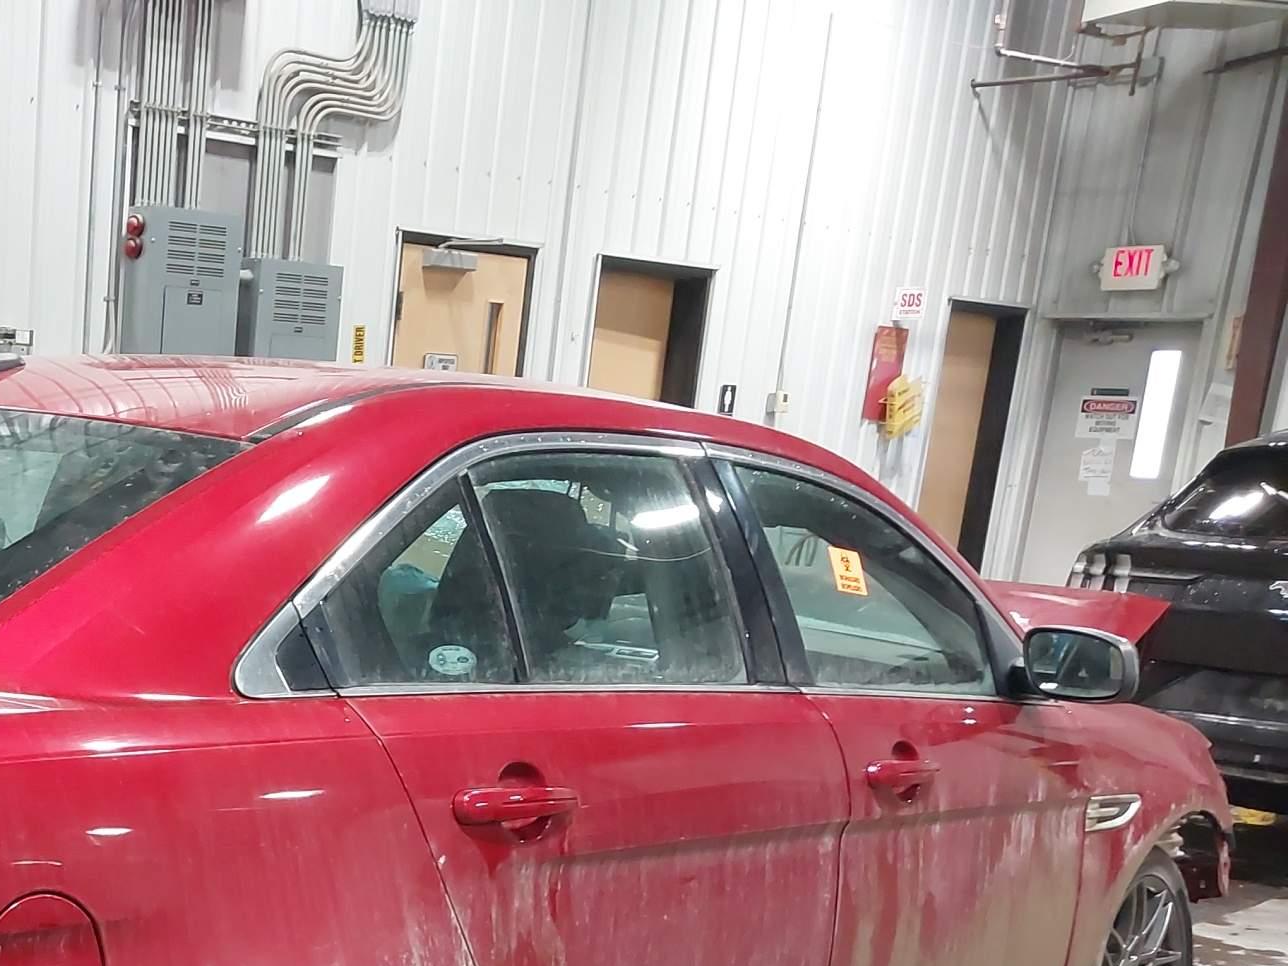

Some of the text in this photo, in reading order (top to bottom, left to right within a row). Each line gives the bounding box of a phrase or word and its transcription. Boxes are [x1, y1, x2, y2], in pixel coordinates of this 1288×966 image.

[1113, 249, 1154, 277] EXIT
[900, 293, 923, 308] SDS
[354, 327, 365, 357] DRIVER
